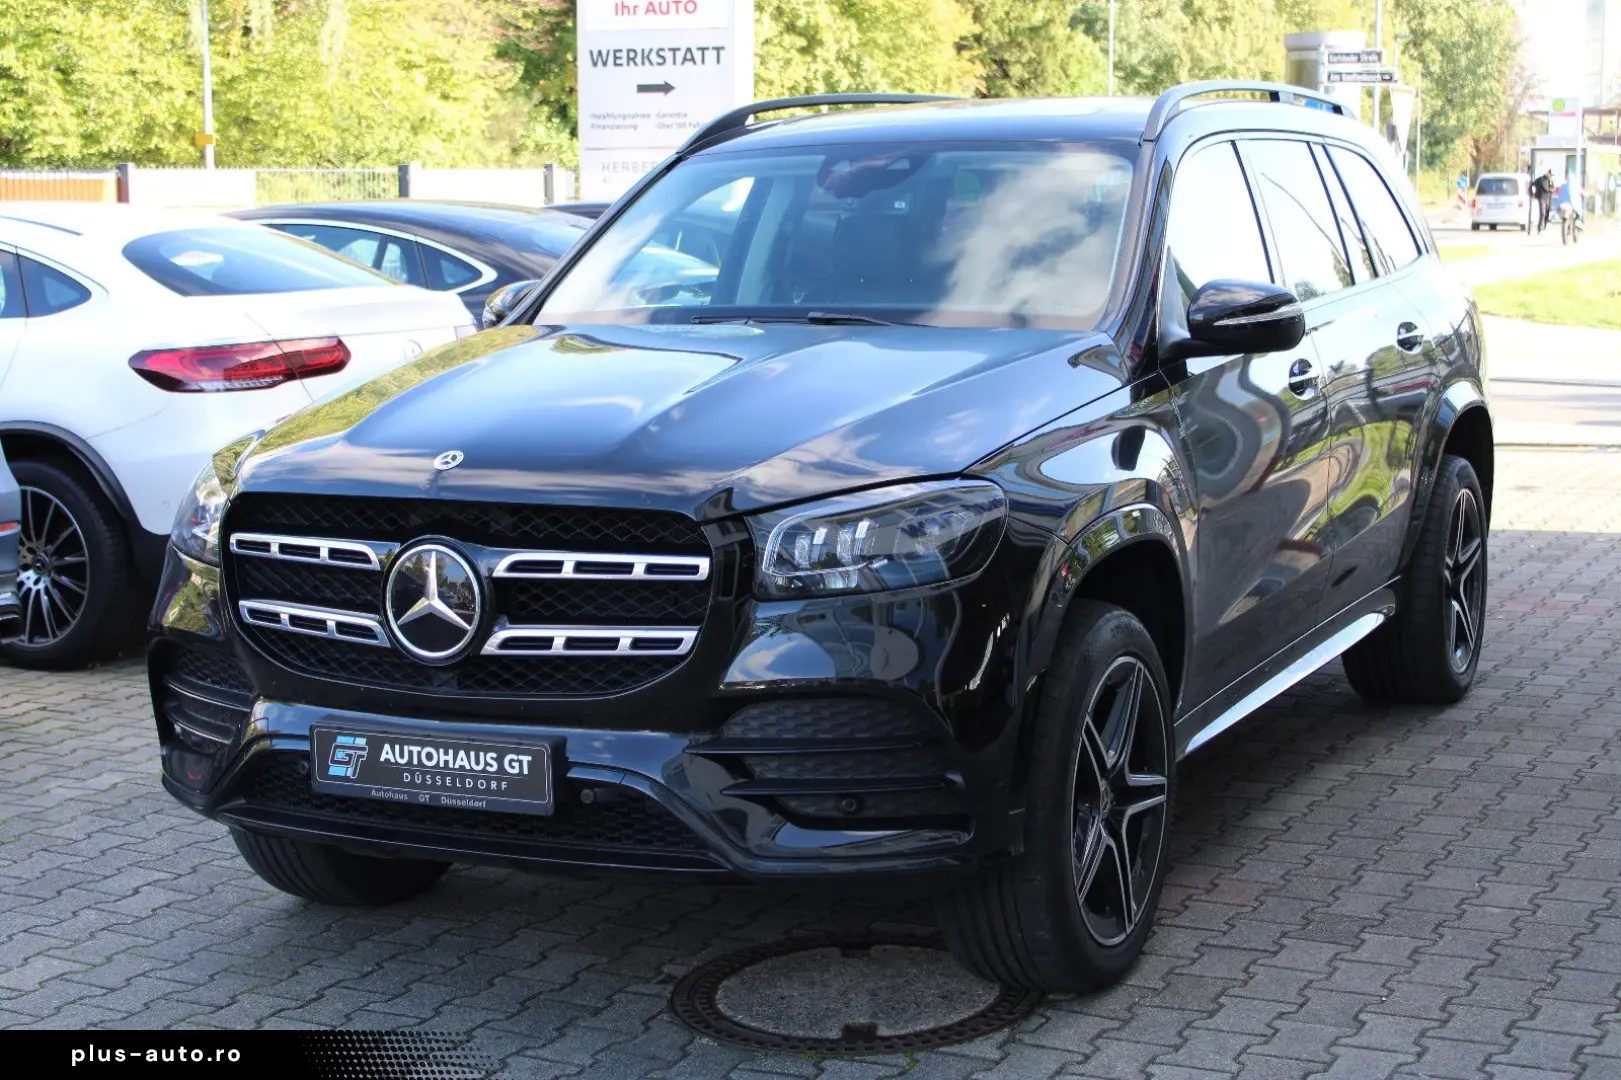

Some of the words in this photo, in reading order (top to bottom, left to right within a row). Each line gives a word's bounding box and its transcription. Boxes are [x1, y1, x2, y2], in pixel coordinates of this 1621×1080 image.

[614, 0, 639, 16] Ihr
[644, 0, 697, 15] AUTO
[589, 46, 725, 68] WERKSTATT
[379, 743, 498, 772] AUTOHAUS
[503, 753, 533, 775] GT
[403, 771, 508, 791] DÜSSELDORF
[371, 789, 408, 800] Autohaus
[418, 794, 431, 803] GT
[441, 796, 487, 808] Düsseldorf
